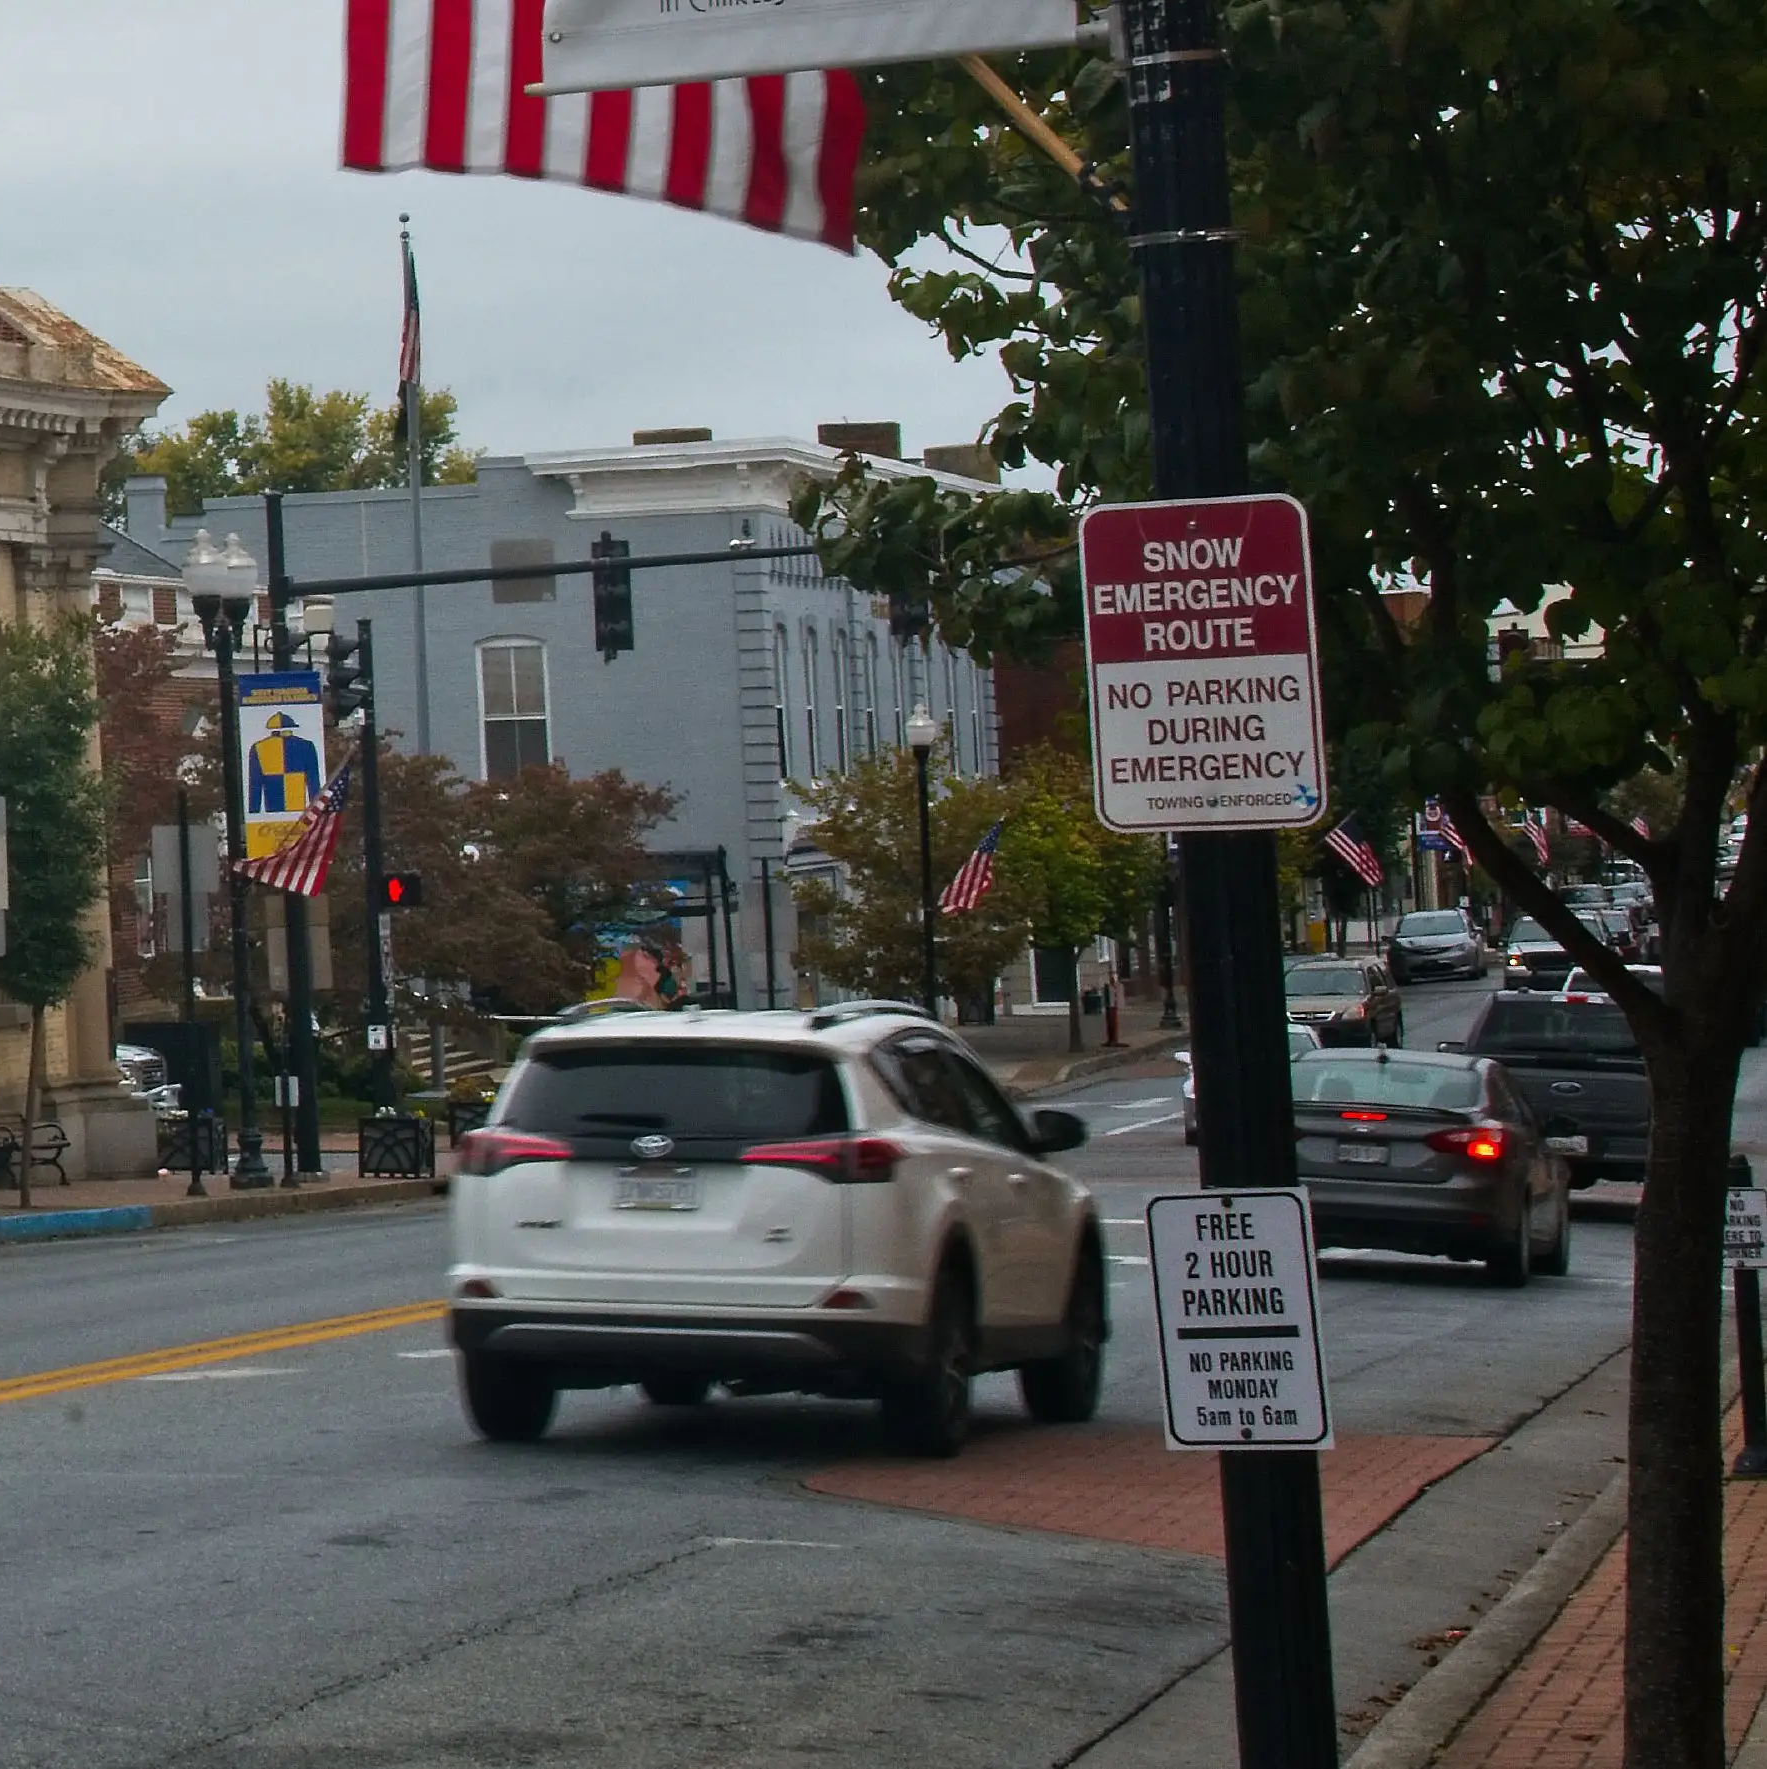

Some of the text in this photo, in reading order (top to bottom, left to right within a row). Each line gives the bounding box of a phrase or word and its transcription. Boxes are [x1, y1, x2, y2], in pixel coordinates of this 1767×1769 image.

[1143, 537, 1244, 573] SNOW
[1094, 574, 1299, 616] EMERGENCY
[1144, 617, 1256, 652] ROUTE
[1108, 675, 1300, 711] NO PARKING
[1147, 713, 1266, 746] DURING
[1110, 751, 1305, 784] EMERGENCY
[1146, 792, 1293, 810] TOWING ENFORCED
[1195, 1213, 1255, 1242] FREE
[1185, 1249, 1274, 1279] 2 HOUR
[1182, 1287, 1285, 1317] PARKING
[1189, 1351, 1294, 1373] NO PARKING
[1207, 1378, 1279, 1400] MONDAY
[1196, 1405, 1299, 1426] 5am to 6am
